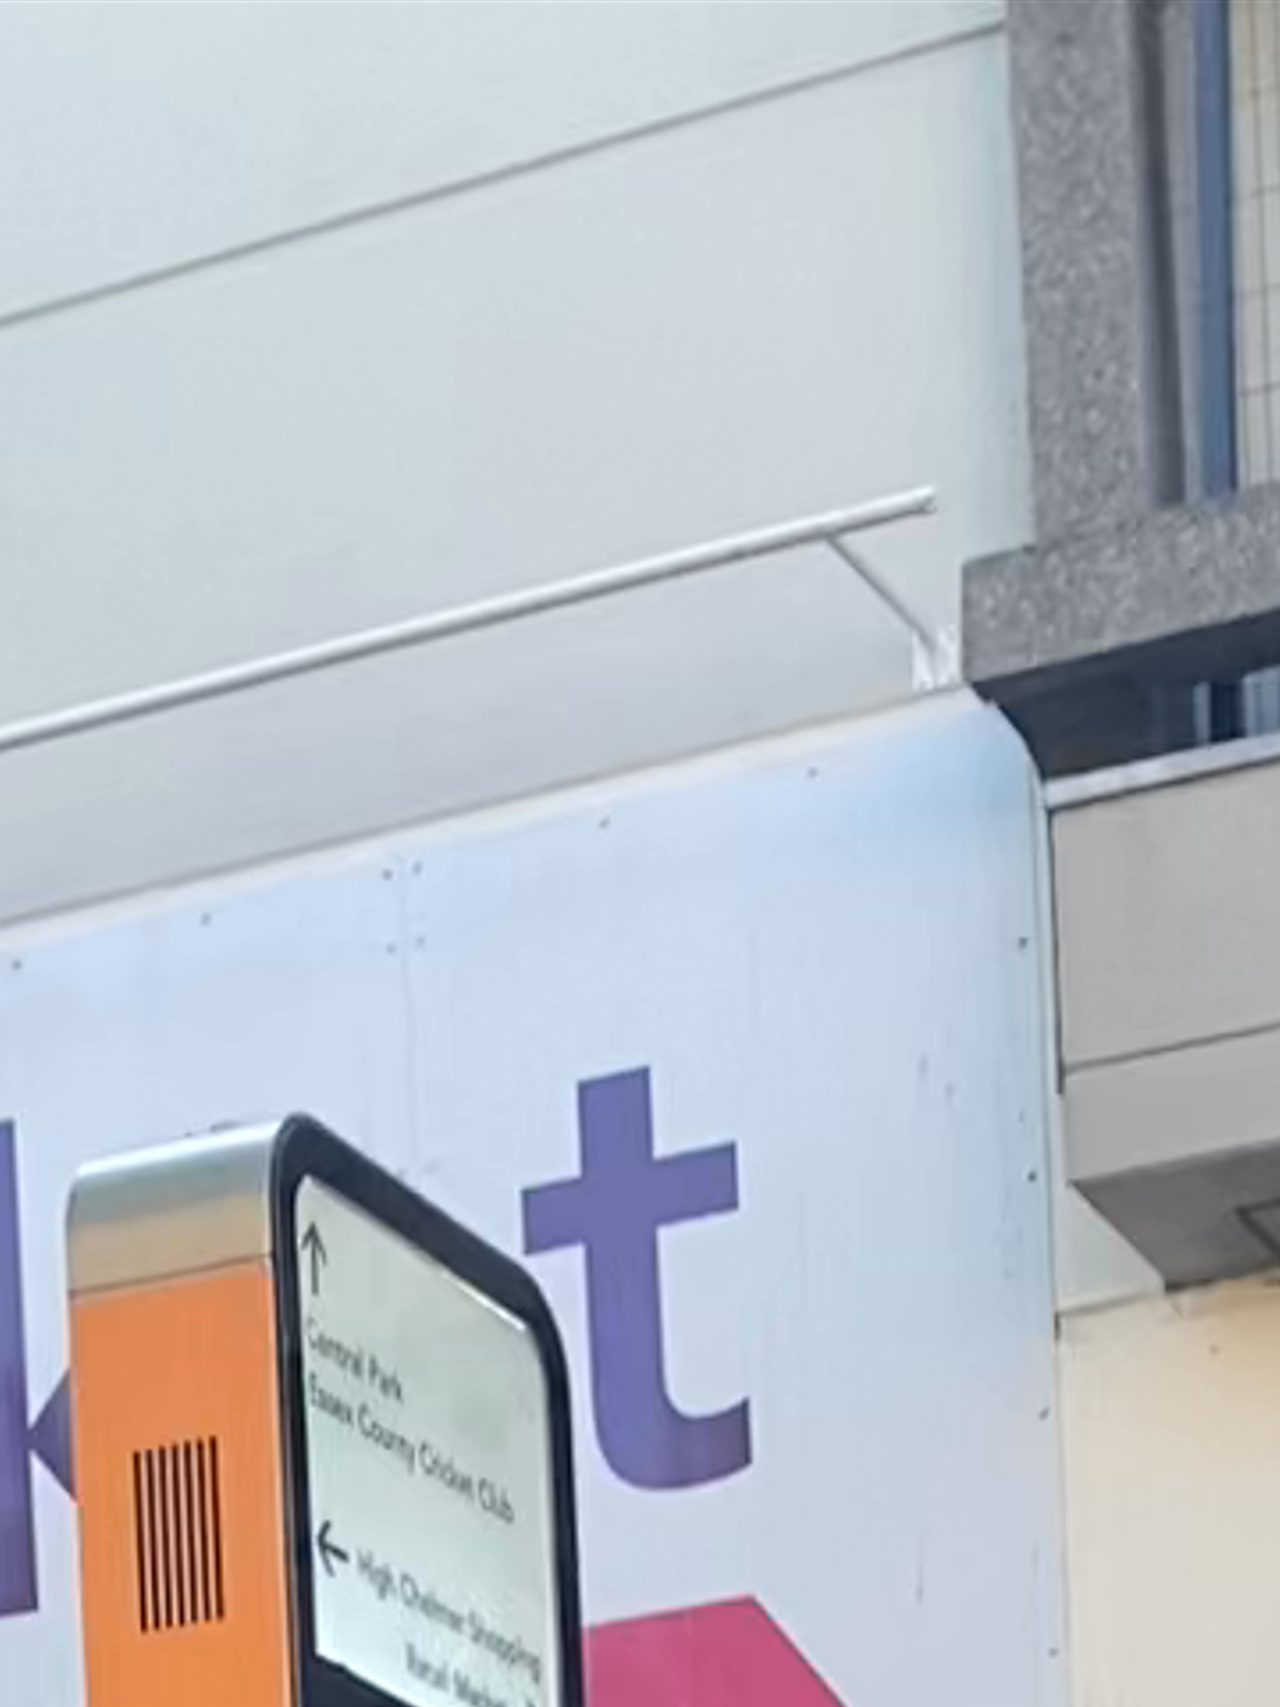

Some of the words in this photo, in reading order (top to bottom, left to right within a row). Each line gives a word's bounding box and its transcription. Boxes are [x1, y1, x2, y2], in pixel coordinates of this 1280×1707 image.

[368, 1353, 404, 1405] Park
[357, 1402, 415, 1475] County
[477, 1477, 516, 1525] Club
[356, 1548, 397, 1600] High
[467, 1610, 541, 1685] Shopping
